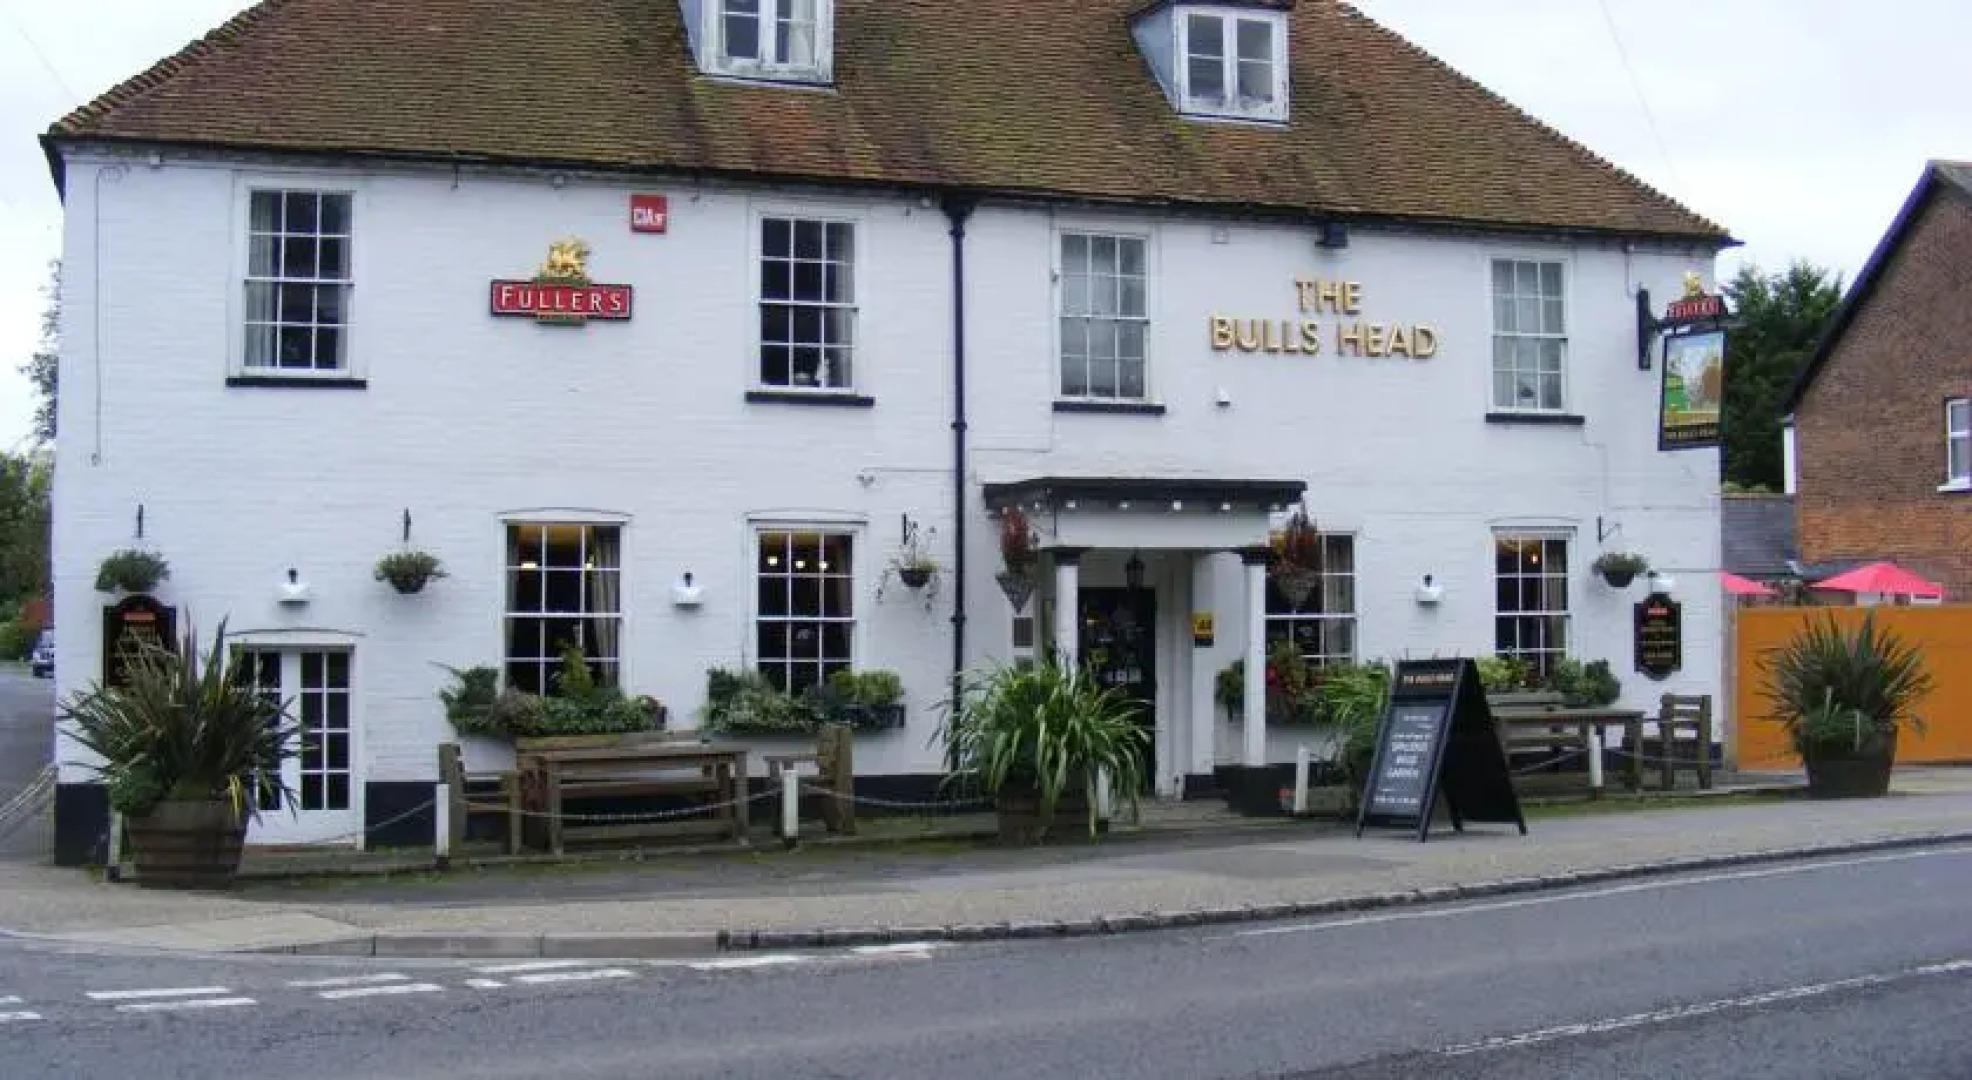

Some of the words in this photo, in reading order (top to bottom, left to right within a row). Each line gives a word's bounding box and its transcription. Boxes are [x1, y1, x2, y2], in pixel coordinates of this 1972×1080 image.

[1295, 280, 1361, 315] THE
[1211, 313, 1319, 355] BULLS
[1337, 322, 1437, 359] HEAD
